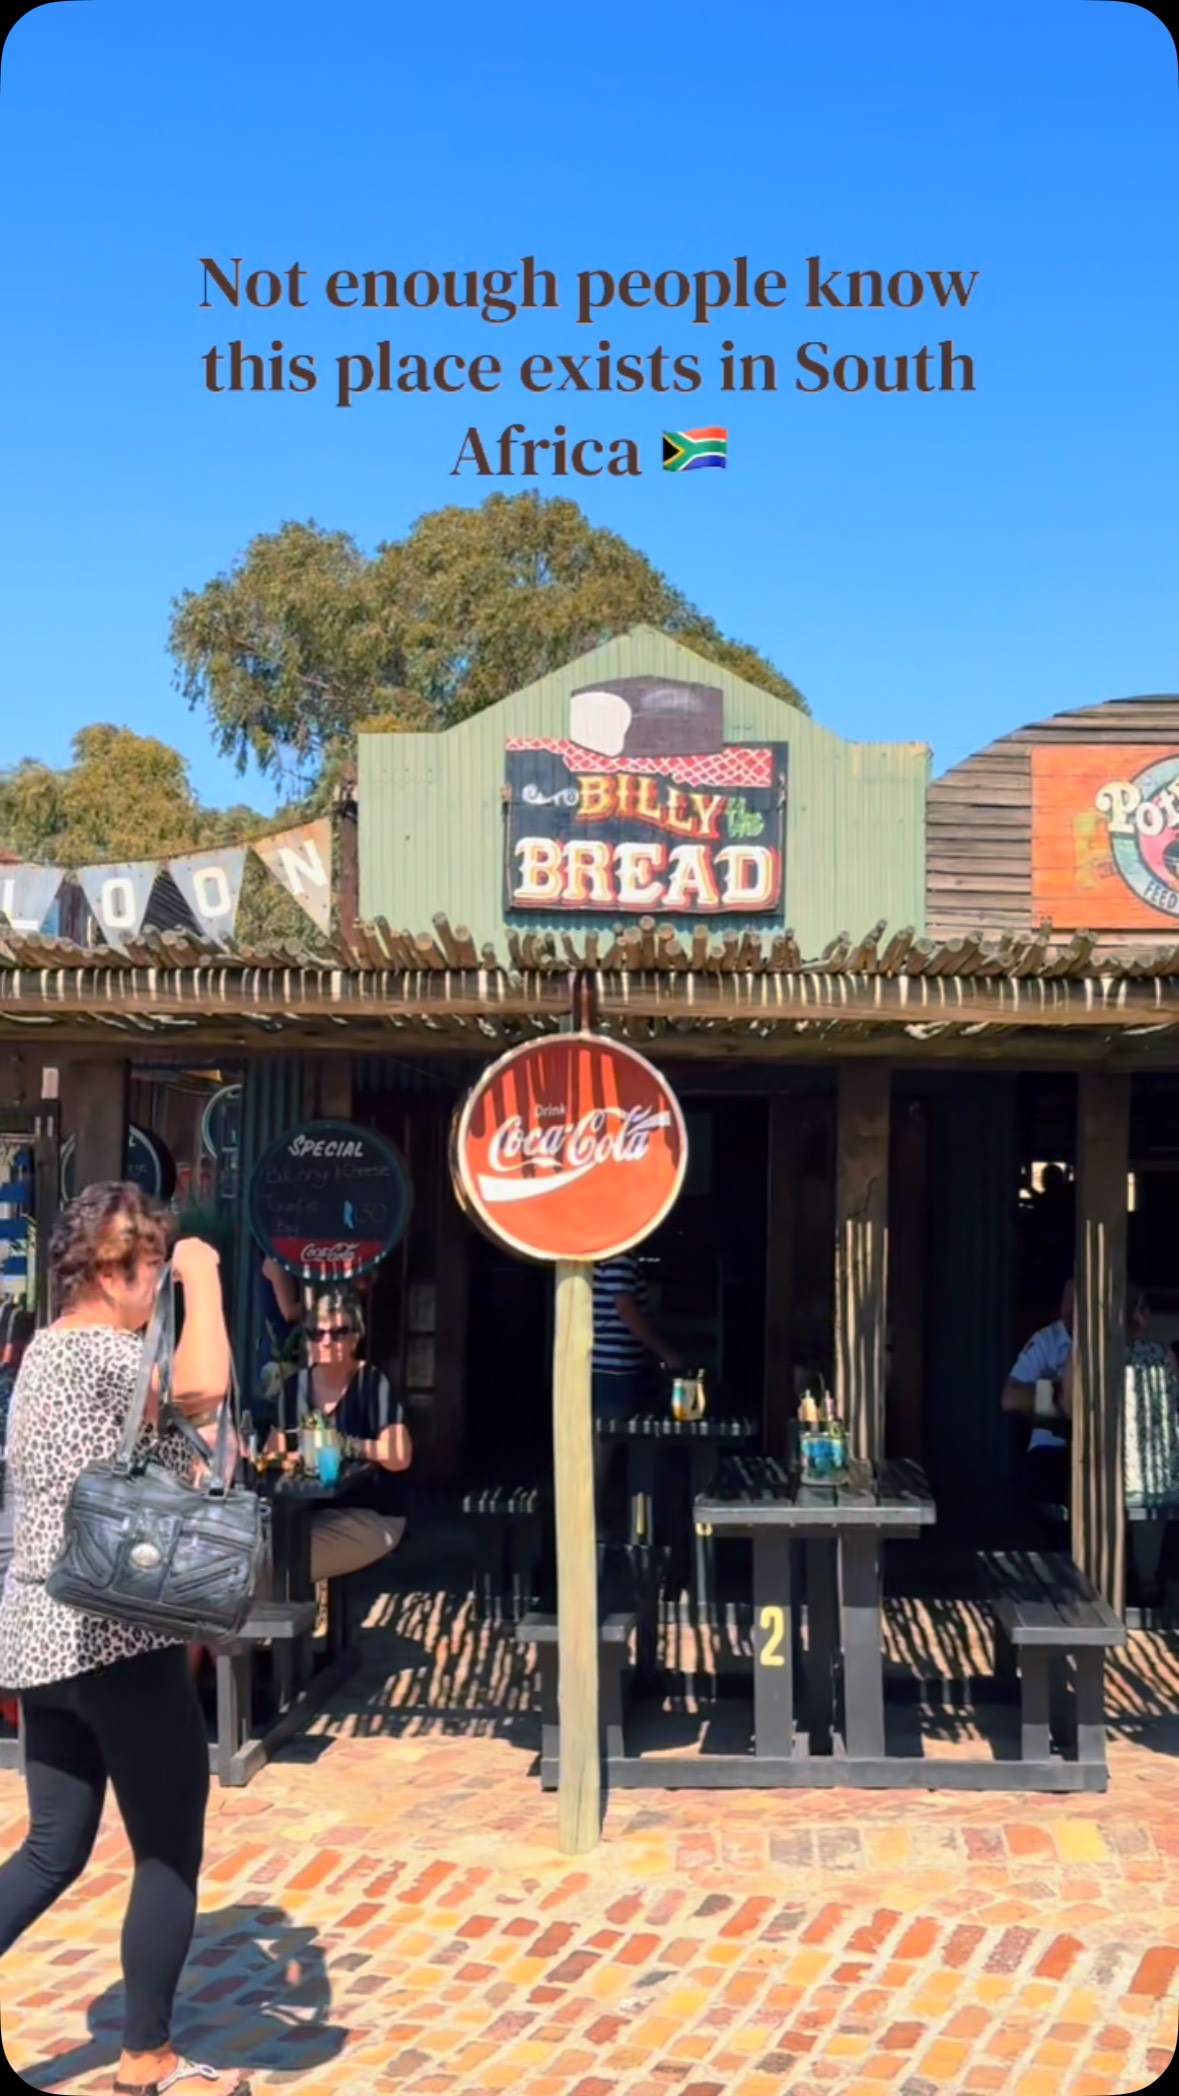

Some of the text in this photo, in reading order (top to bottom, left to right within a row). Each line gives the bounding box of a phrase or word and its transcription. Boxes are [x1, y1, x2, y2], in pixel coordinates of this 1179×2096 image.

[575, 774, 721, 839] BILLY
[1095, 779, 1179, 836] Pot
[514, 837, 776, 911] BREAD
[535, 1104, 566, 1117] Drink
[288, 1134, 364, 1158] SPECIAL
[759, 1605, 785, 1666] 2
